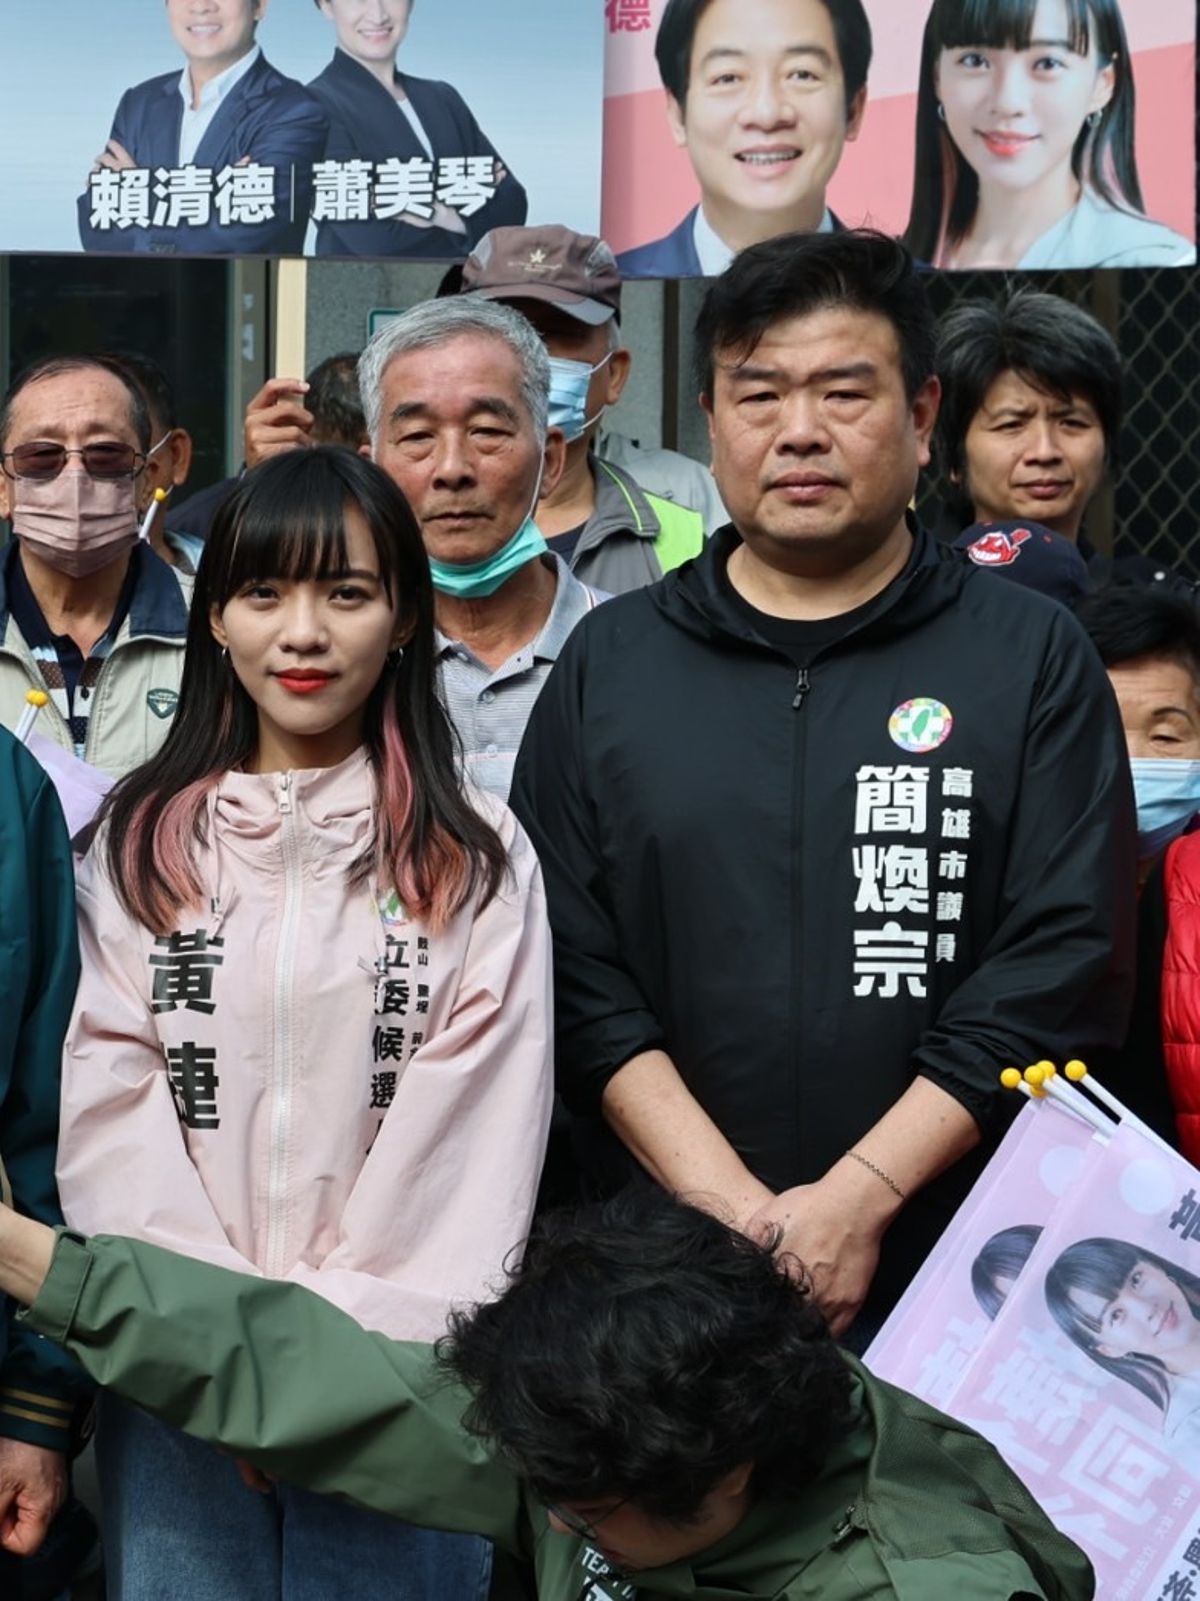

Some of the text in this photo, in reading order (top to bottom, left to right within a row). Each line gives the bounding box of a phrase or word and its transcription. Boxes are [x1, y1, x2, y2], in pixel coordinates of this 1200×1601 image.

[89, 155, 497, 230] 賴清德 蕭美琴
[852, 765, 930, 999] 簡煥宗
[936, 767, 973, 963] 高雄市議員
[367, 933, 410, 1155] 立委候選
